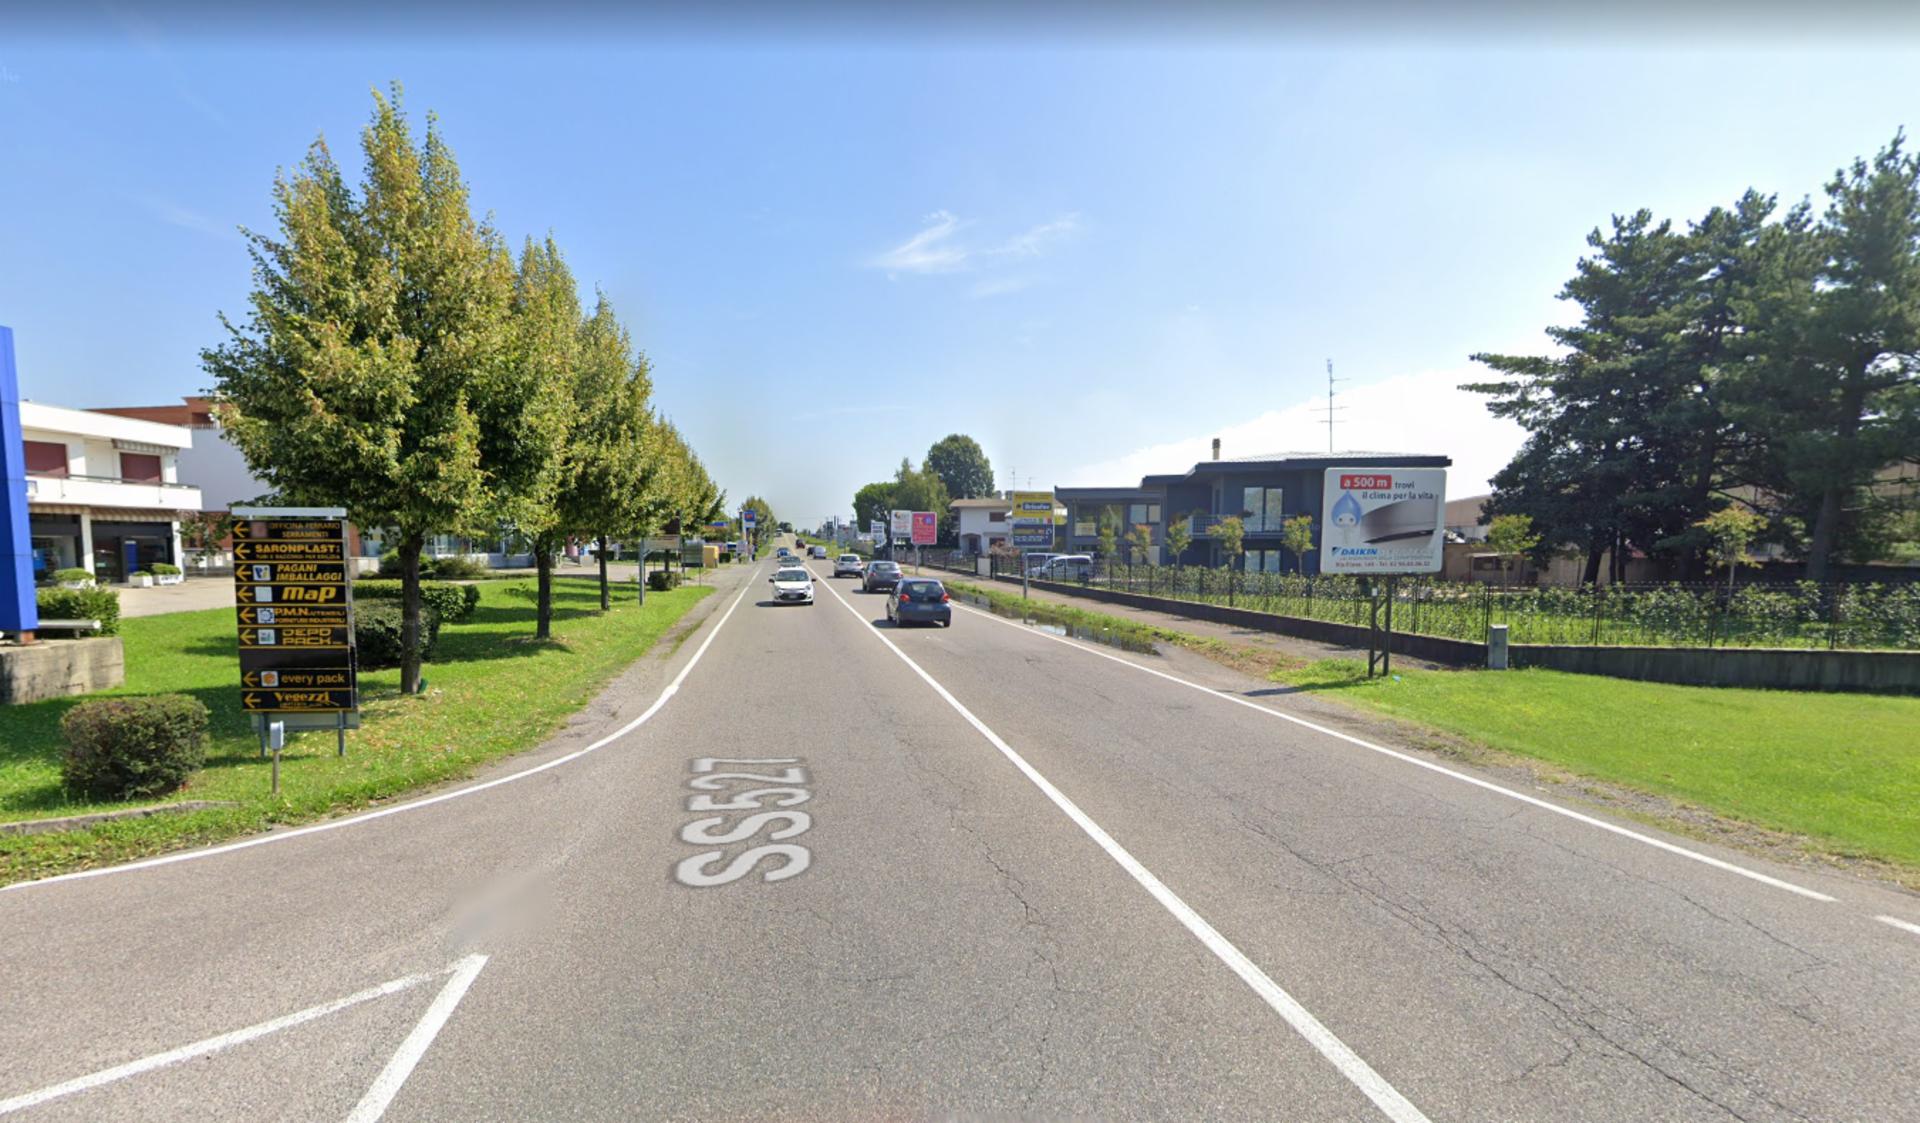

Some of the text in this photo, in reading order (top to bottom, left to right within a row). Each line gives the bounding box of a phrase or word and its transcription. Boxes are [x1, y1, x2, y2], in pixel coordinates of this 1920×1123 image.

[1343, 477, 1388, 487] a 500 m
[1395, 480, 1415, 489] trovi
[1362, 491, 1433, 502] il clima per la vita
[255, 544, 336, 553] SARONPLAST
[1341, 548, 1378, 556] DAIKIN
[276, 564, 318, 572] PAGANI
[276, 572, 342, 581] IMBALLAGGI
[282, 637, 331, 645] PACK
[281, 673, 345, 685] every pack
